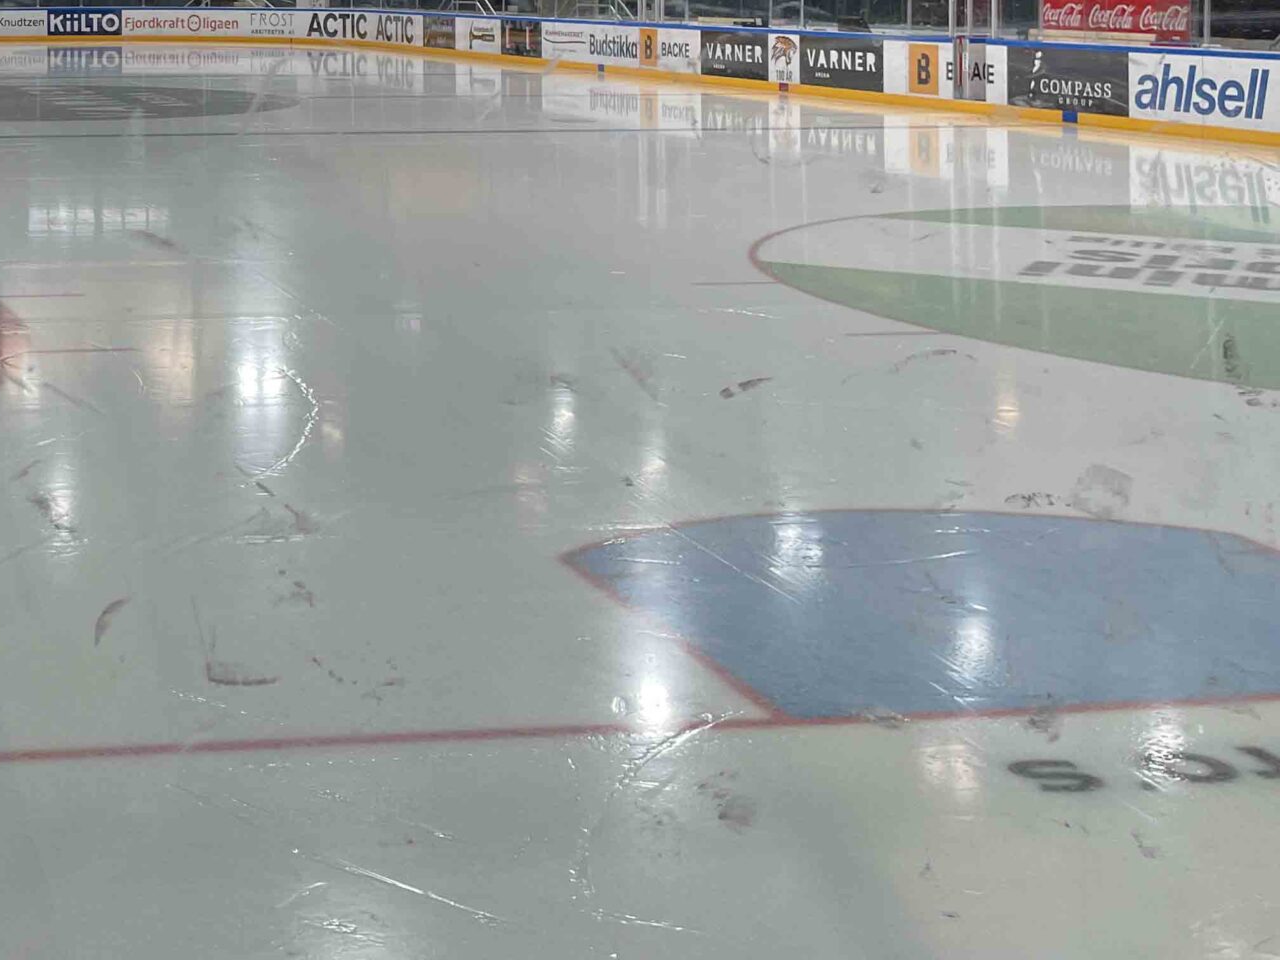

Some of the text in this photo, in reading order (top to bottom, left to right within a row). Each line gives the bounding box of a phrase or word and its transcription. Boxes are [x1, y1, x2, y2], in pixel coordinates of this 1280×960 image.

[124, 17, 238, 31] Fjordkraft ligaen
[250, 13, 294, 26] FROST
[306, 13, 367, 39] ACTIC
[375, 15, 414, 44] ACTIC
[589, 34, 638, 59] Budstikka
[661, 41, 690, 58] BACKE
[706, 42, 762, 63] VARNER
[807, 48, 876, 72] VARNER
[1040, 78, 1112, 98] COMPASS
[1135, 63, 1270, 120] ahlsell
